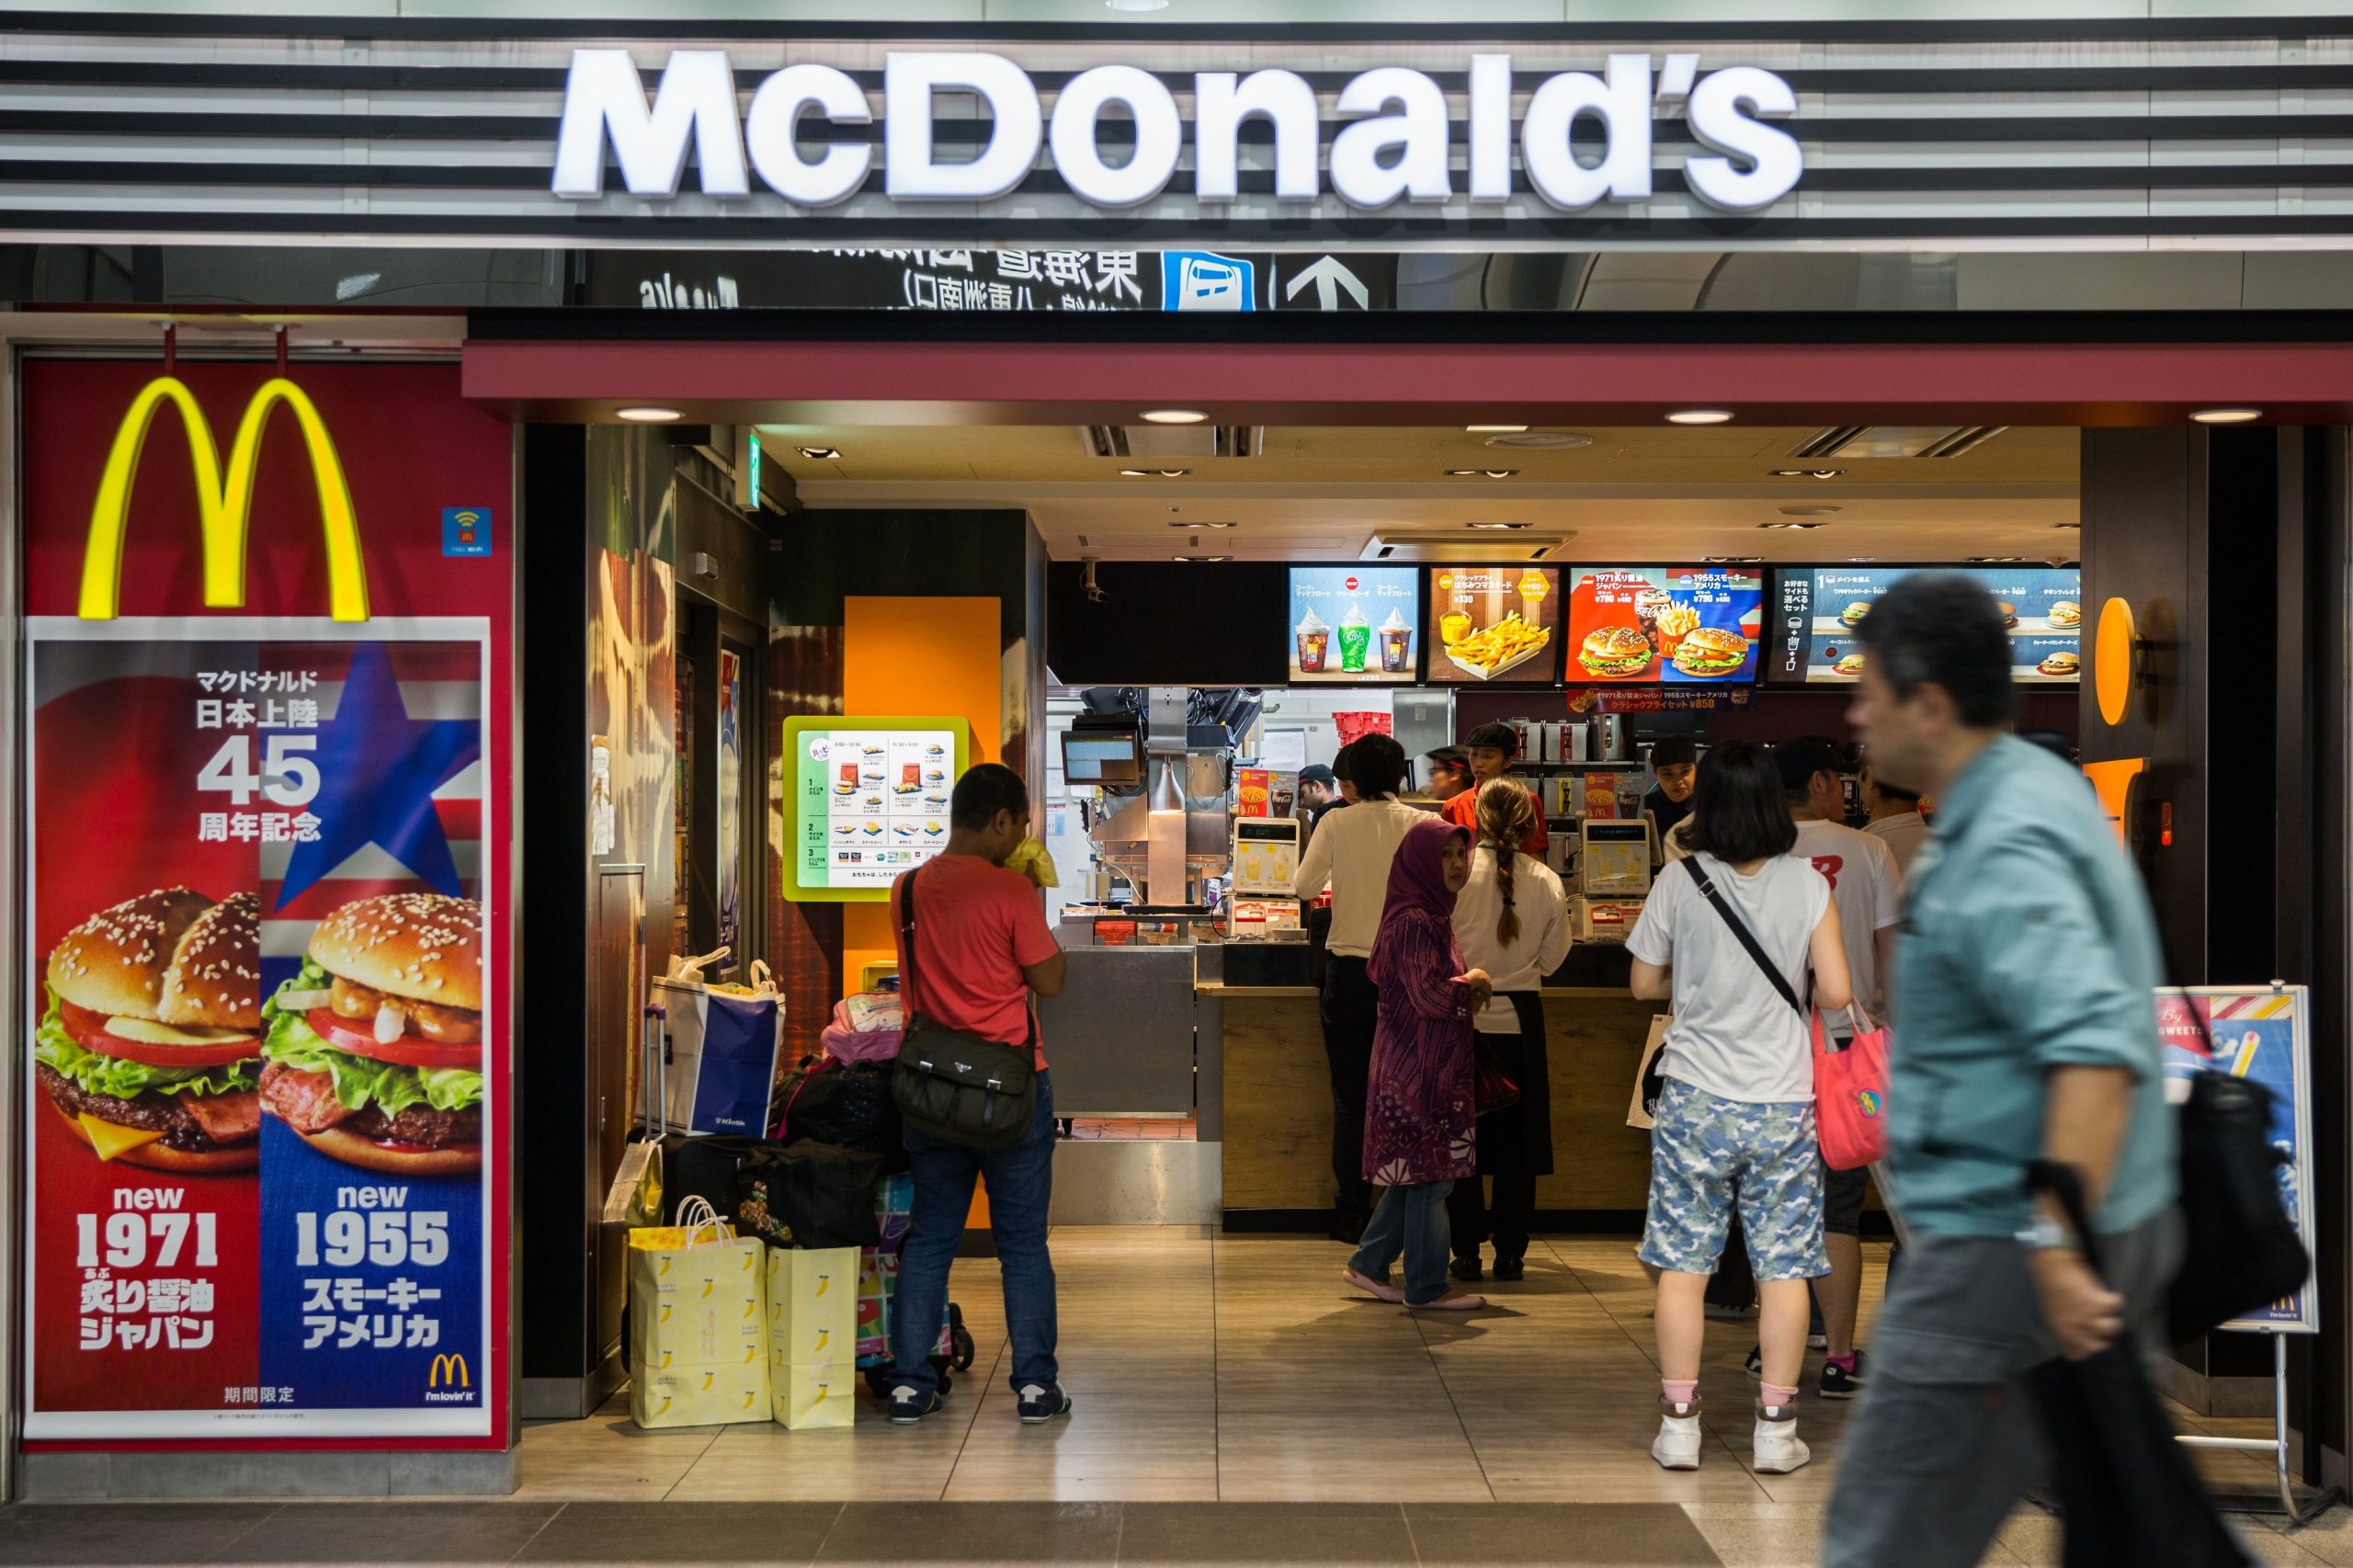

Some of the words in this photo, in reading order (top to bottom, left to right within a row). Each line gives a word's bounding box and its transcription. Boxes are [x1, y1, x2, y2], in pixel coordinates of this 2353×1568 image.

[551, 49, 1803, 210] McDonald's
[1454, 581, 1513, 589] はちみつマスタード
[1693, 574, 1747, 582] 1955スモーキー
[1784, 596, 1808, 604] 選べる
[1784, 604, 1807, 612] セット
[197, 670, 318, 692] マクドナルド
[197, 699, 318, 728] 日本上陸
[1611, 700, 1688, 710] クラシックフライセット
[1689, 699, 1715, 710] ¥850
[197, 734, 321, 806] 45
[198, 812, 322, 842] 周年記念
[808, 823, 814, 831] 2
[808, 848, 814, 857] 3
[114, 1187, 185, 1210] new
[337, 1186, 408, 1209] new
[76, 1212, 218, 1267] 1971
[296, 1210, 449, 1267] 1955
[80, 1278, 214, 1313] 炙り醤油
[302, 1277, 441, 1312] スモーキー
[80, 1315, 214, 1350] ジャパン
[303, 1314, 439, 1349] アメリカ
[223, 1386, 294, 1403] 期間限定
